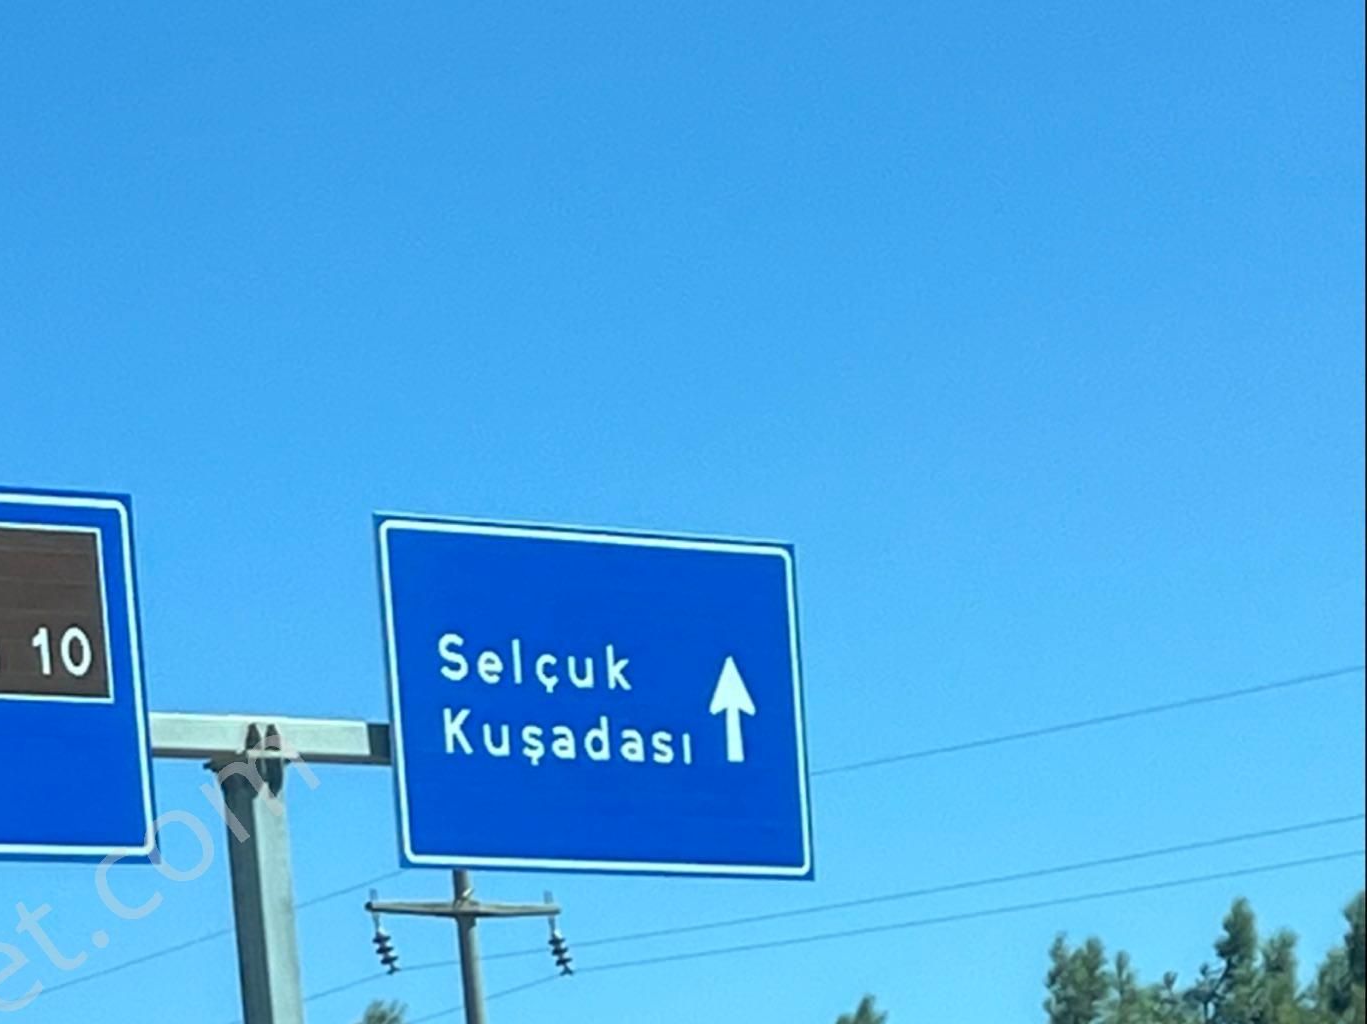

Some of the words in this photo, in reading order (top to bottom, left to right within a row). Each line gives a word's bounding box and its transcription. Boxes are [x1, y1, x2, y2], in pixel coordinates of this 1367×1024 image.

[32, 626, 92, 677] 10
[438, 632, 632, 693] Selçuk
[443, 707, 693, 767] Kuşadası
